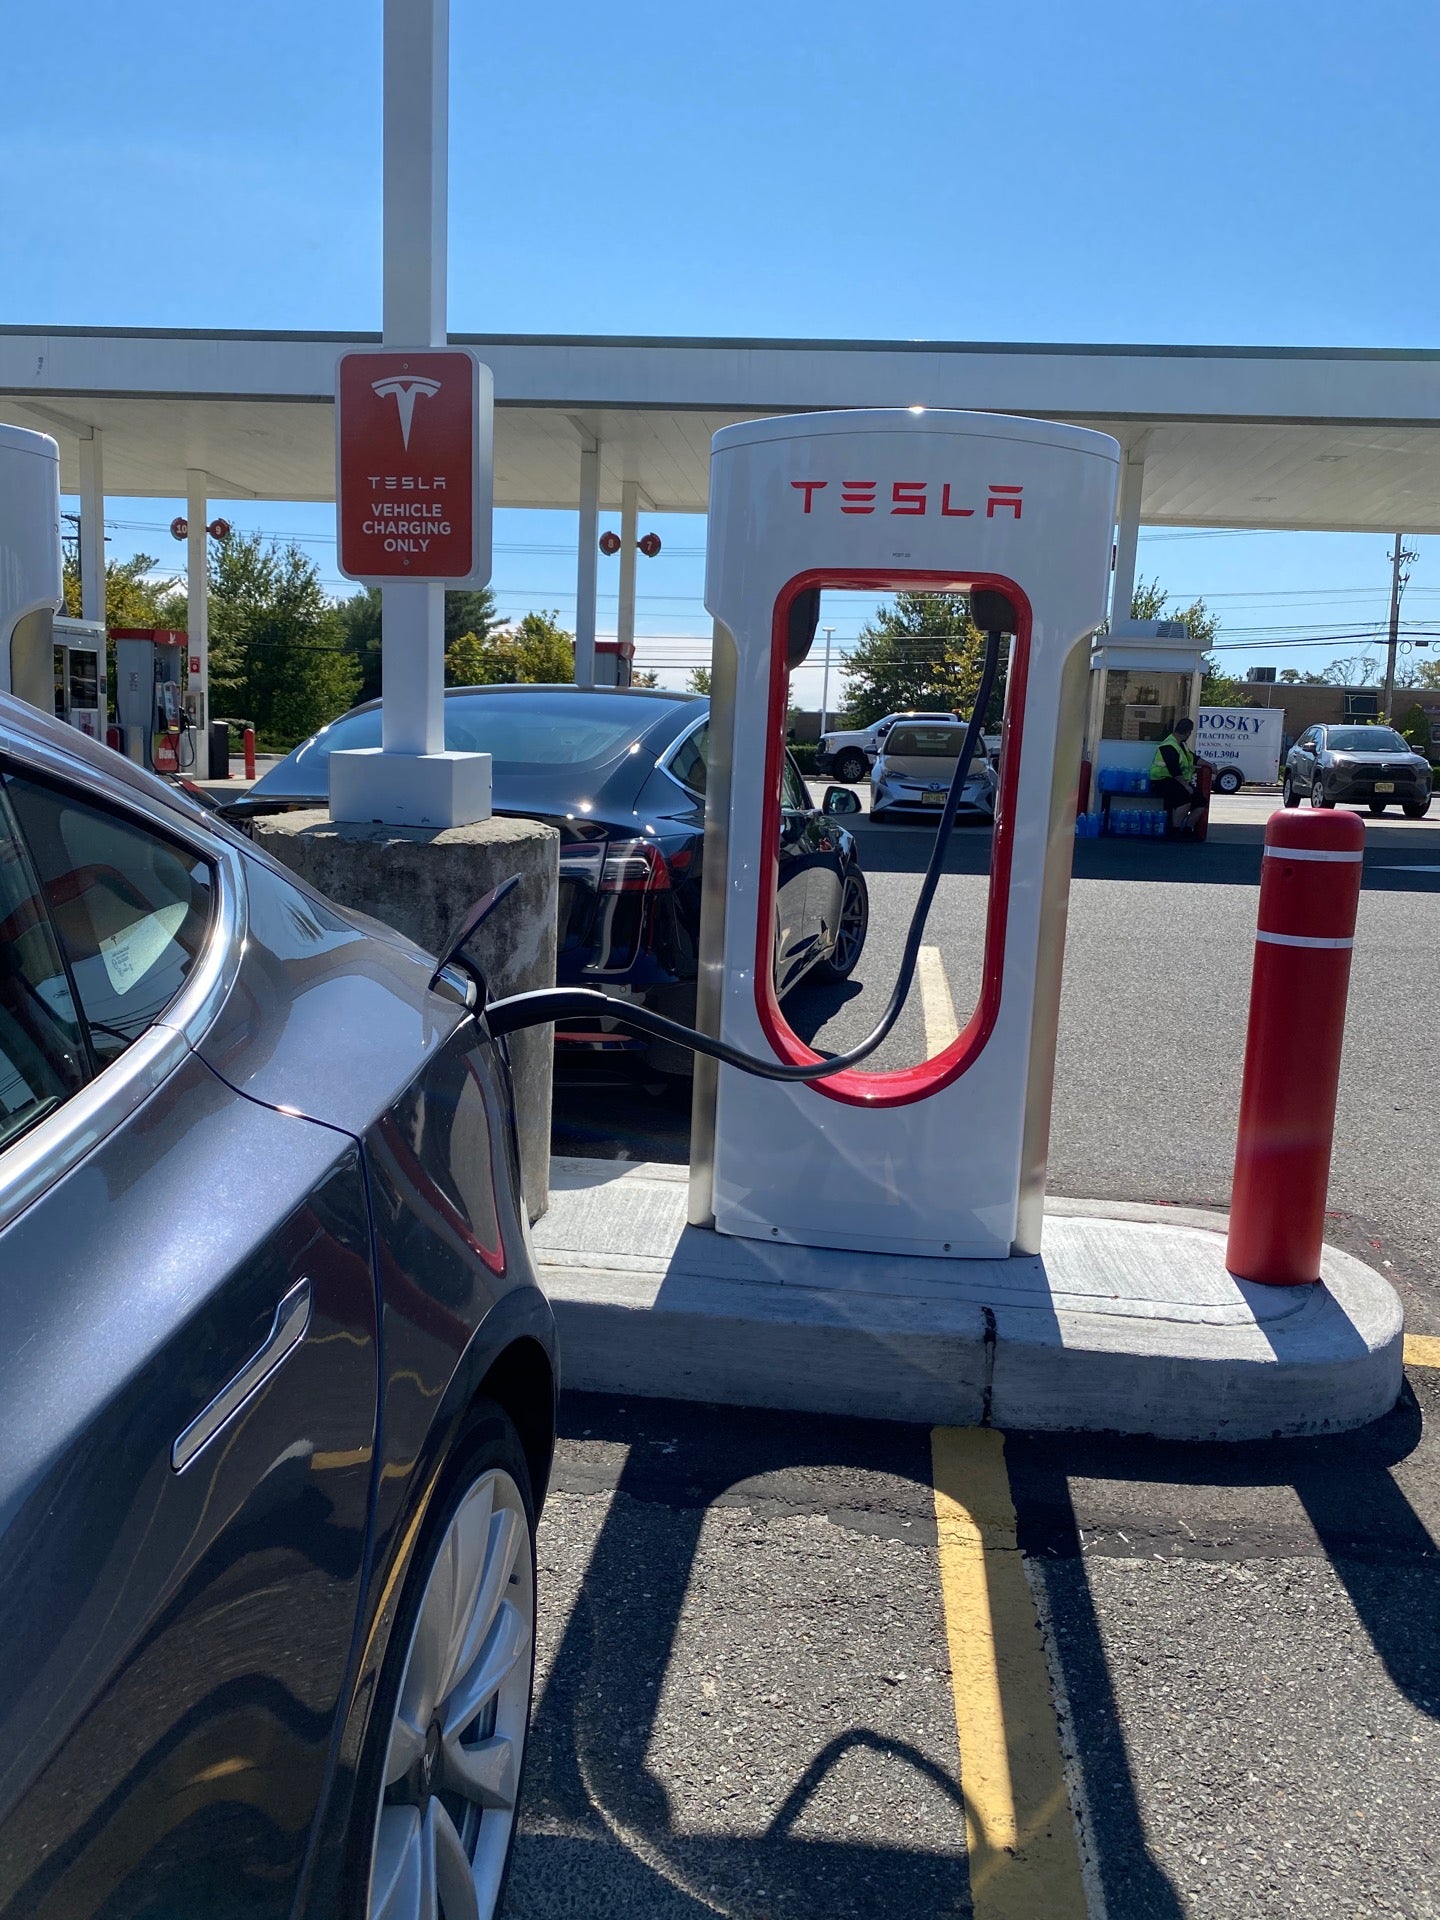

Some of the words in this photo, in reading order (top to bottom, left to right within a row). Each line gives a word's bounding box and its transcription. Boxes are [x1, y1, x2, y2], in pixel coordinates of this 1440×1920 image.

[367, 476, 446, 490] TESLA
[790, 481, 1023, 519] TESLA
[371, 503, 442, 517] VEHICLE
[176, 524, 187, 534] 10
[362, 520, 451, 535] CHARGING
[383, 538, 430, 552] ONLY
[608, 539, 614, 548] 8
[647, 541, 652, 551] 7
[1196, 732, 1236, 741] TRACTING
[1195, 749, 1240, 759] 2.961.3904
